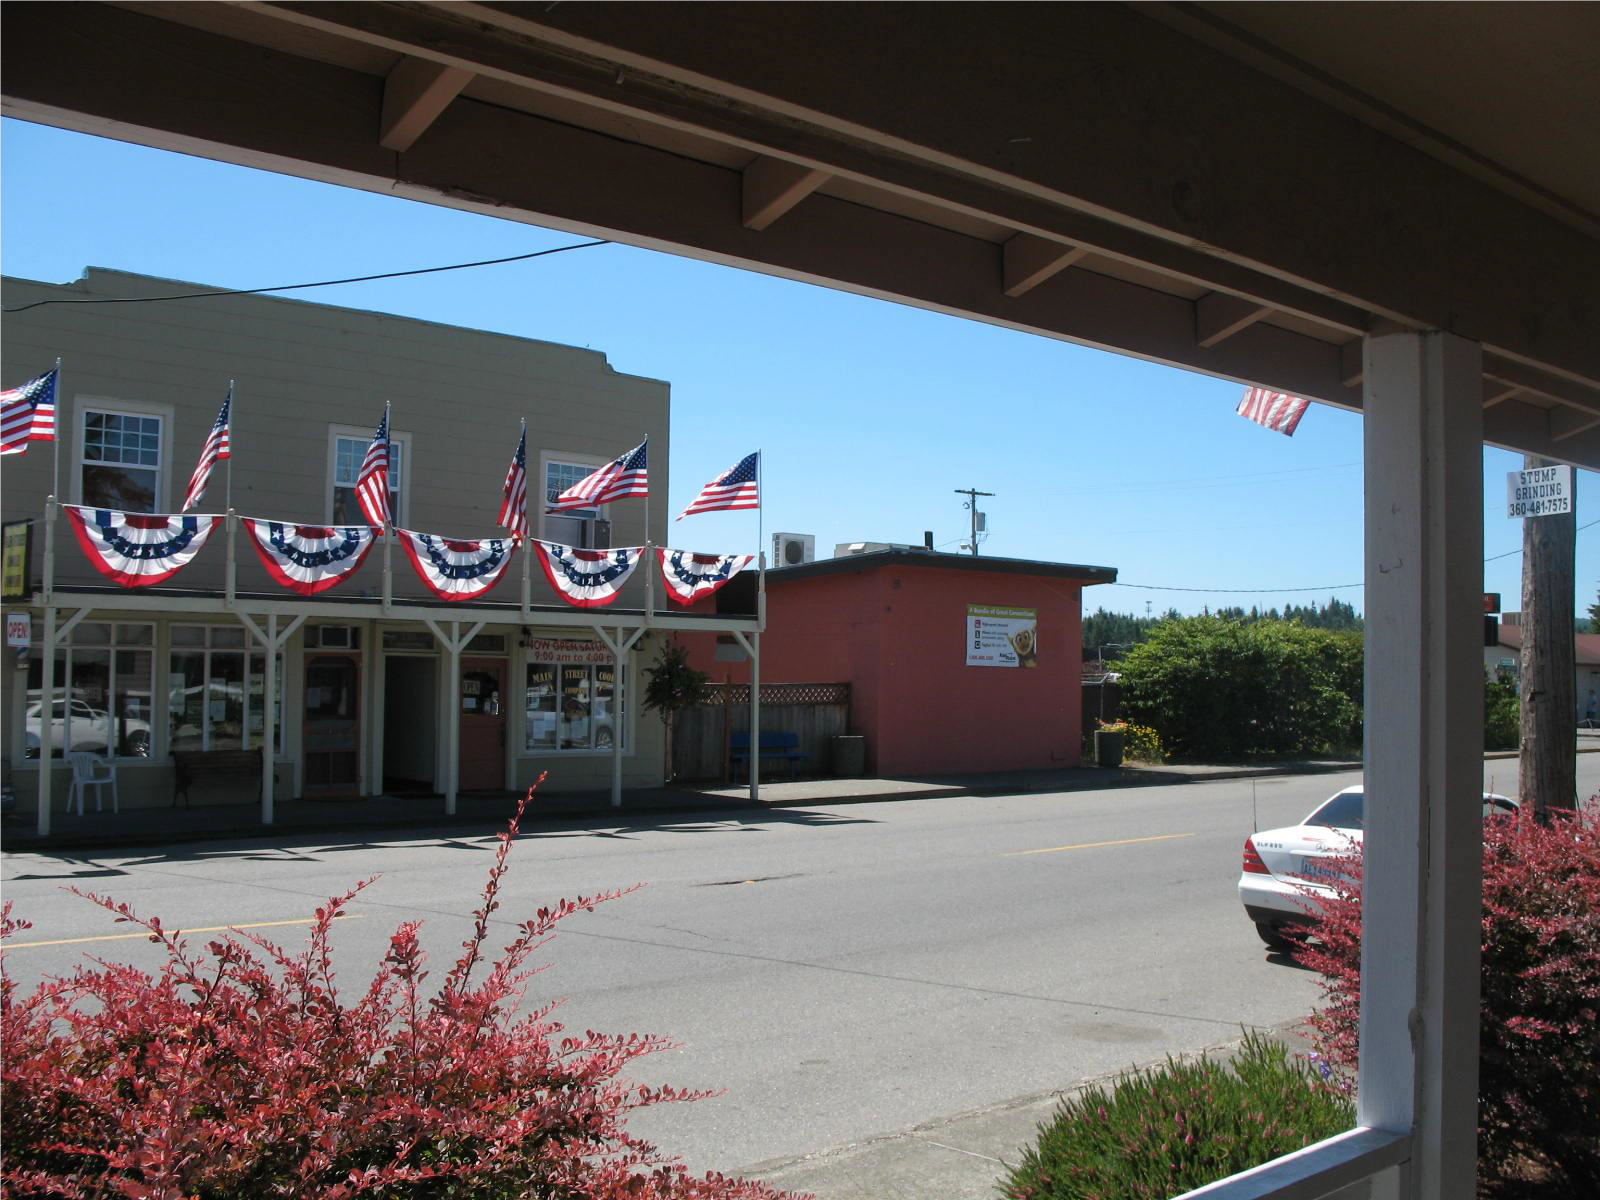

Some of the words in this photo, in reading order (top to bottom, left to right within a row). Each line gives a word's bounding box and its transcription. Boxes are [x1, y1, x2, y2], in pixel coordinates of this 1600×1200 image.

[1520, 468, 1557, 485] STUMP
[1515, 482, 1562, 500] GRINDING
[535, 652, 554, 661] 9:00
[556, 654, 571, 662] am
[573, 654, 583, 662] to
[585, 652, 604, 662] 4:00
[532, 671, 553, 684] MAIN
[564, 669, 589, 680] STREET
